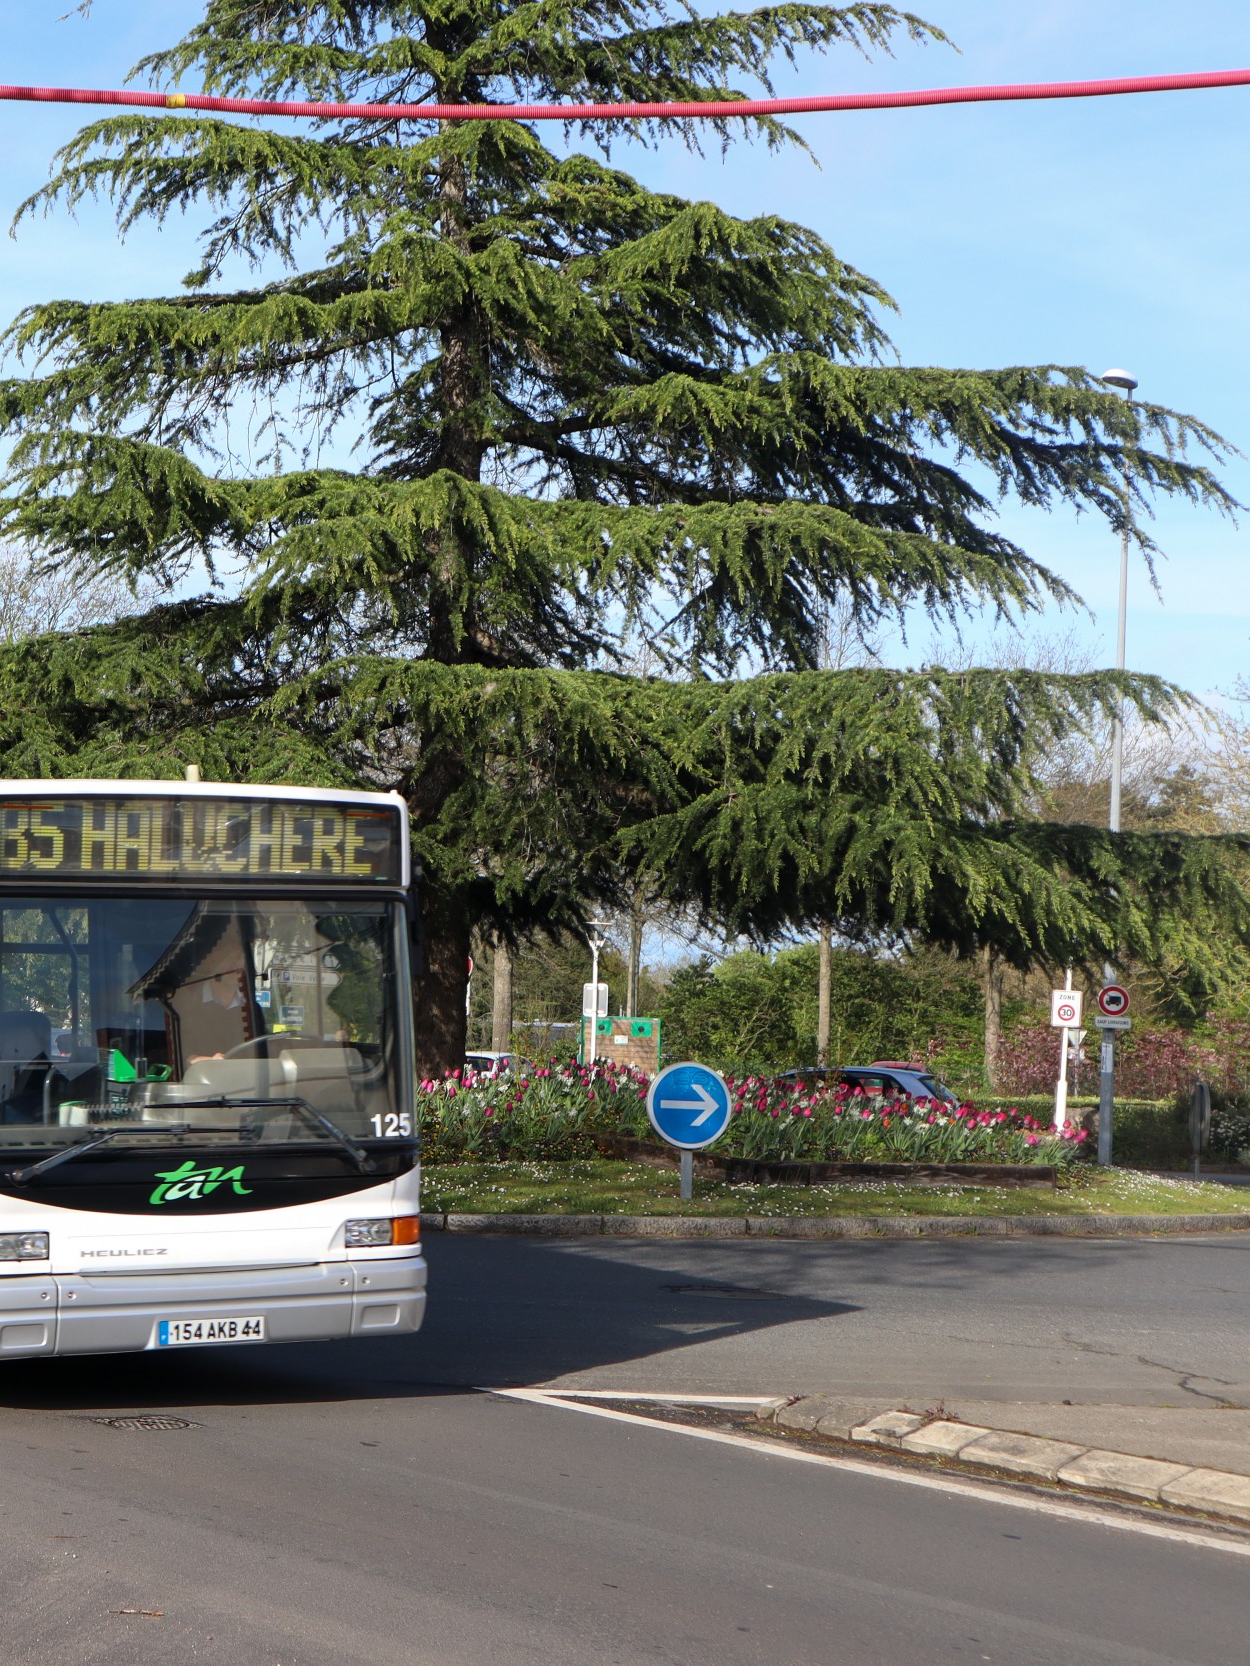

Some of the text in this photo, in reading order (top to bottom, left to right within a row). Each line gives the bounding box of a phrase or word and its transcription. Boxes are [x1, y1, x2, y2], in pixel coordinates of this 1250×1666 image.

[81, 801, 373, 874] HALUCHERE
[1062, 1008, 1072, 1017] 30
[370, 1112, 411, 1137] 125
[149, 1160, 254, 1205] tan
[80, 1248, 168, 1258] HEULIEZ
[174, 1319, 261, 1341] 154 AKB 44
